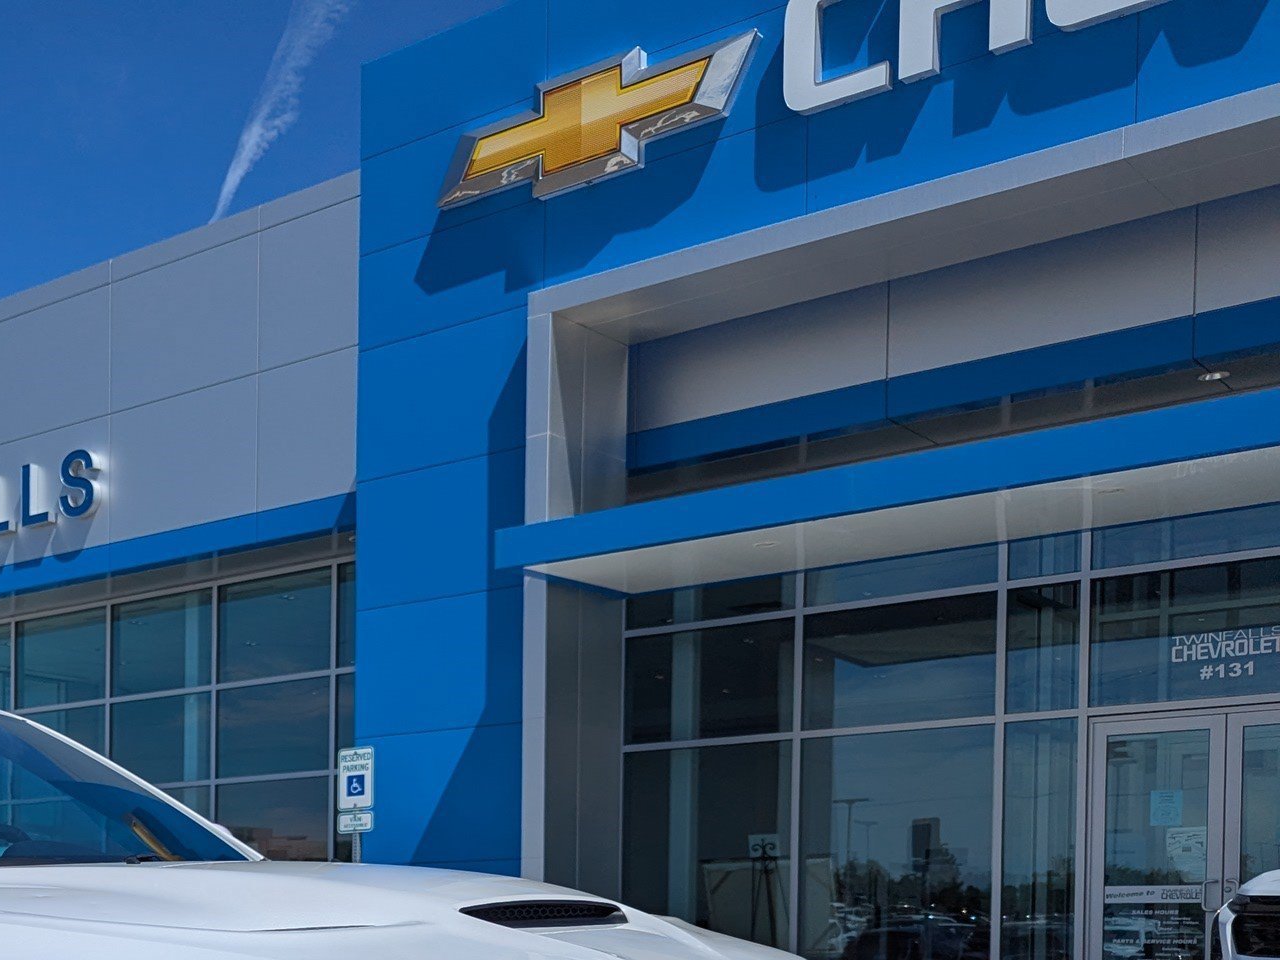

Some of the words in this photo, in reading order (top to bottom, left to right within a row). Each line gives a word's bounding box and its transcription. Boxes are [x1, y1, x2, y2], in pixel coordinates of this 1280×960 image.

[1200, 661, 1254, 681] #131
[340, 752, 372, 763] RESERVED
[342, 763, 369, 773] PARKING
